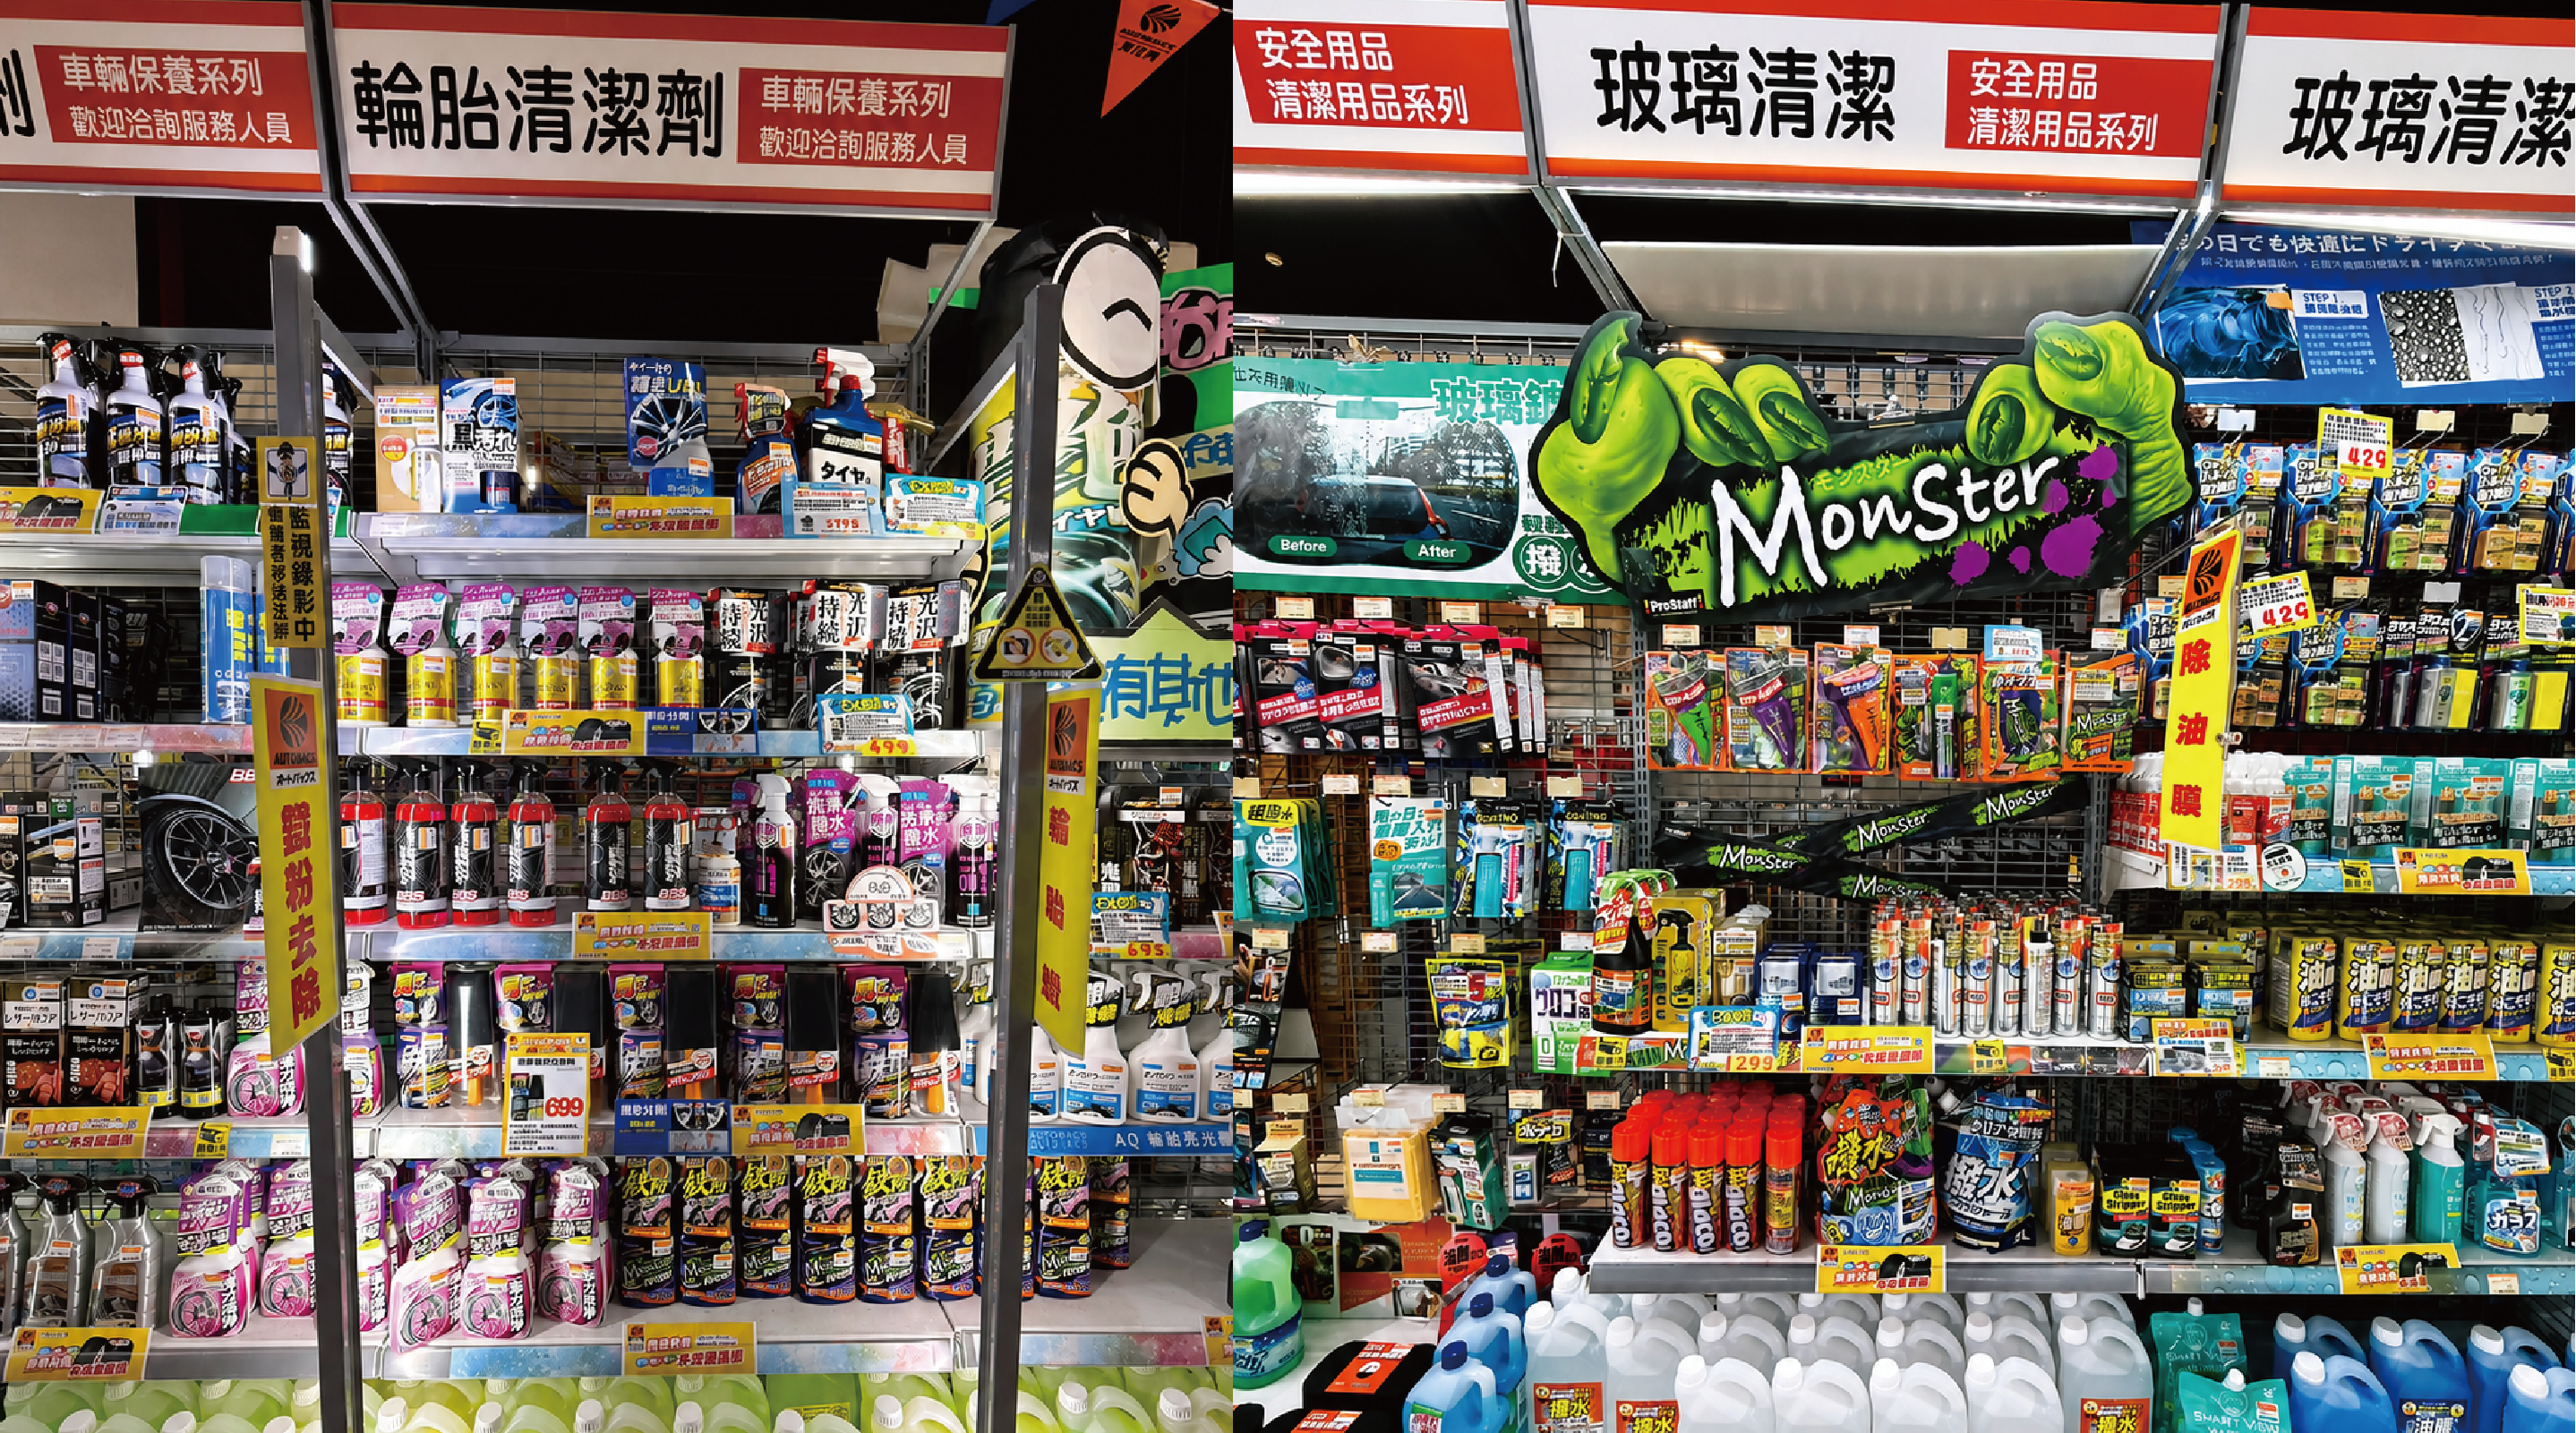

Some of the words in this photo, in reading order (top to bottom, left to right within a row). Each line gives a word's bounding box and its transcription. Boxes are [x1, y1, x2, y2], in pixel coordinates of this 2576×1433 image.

[1256, 28, 1394, 72] 安全用品
[59, 54, 263, 97] 車輛保養系列
[1591, 39, 1896, 141] 玻璃清潔
[1970, 57, 2098, 101] 安全用品
[350, 59, 724, 159] 輪胎清潔劑
[759, 75, 951, 120] 車輛保養系列
[1268, 79, 1469, 125] 清潔用品系列
[2282, 69, 2576, 168] 玻璃清潔
[70, 105, 293, 145] 歡迎洽詢服務人員
[759, 125, 968, 166] 歡迎洽詢服務人員
[1967, 107, 2159, 153] 清潔用品系列
[2348, 446, 2388, 468] 429
[1280, 539, 1327, 552] Before
[1418, 544, 1457, 558] After
[289, 506, 315, 642] 監視錄影中
[2262, 601, 2309, 627] 429
[870, 739, 909, 755] 499
[2170, 637, 2212, 818] 除油膜
[230, 768, 257, 784] BB
[1127, 942, 1166, 957] 695
[1735, 1055, 1774, 1071] 299
[544, 1096, 584, 1117] 699
[1114, 1132, 1140, 1150] AQ
[1944, 1151, 2020, 1205] 撥水
